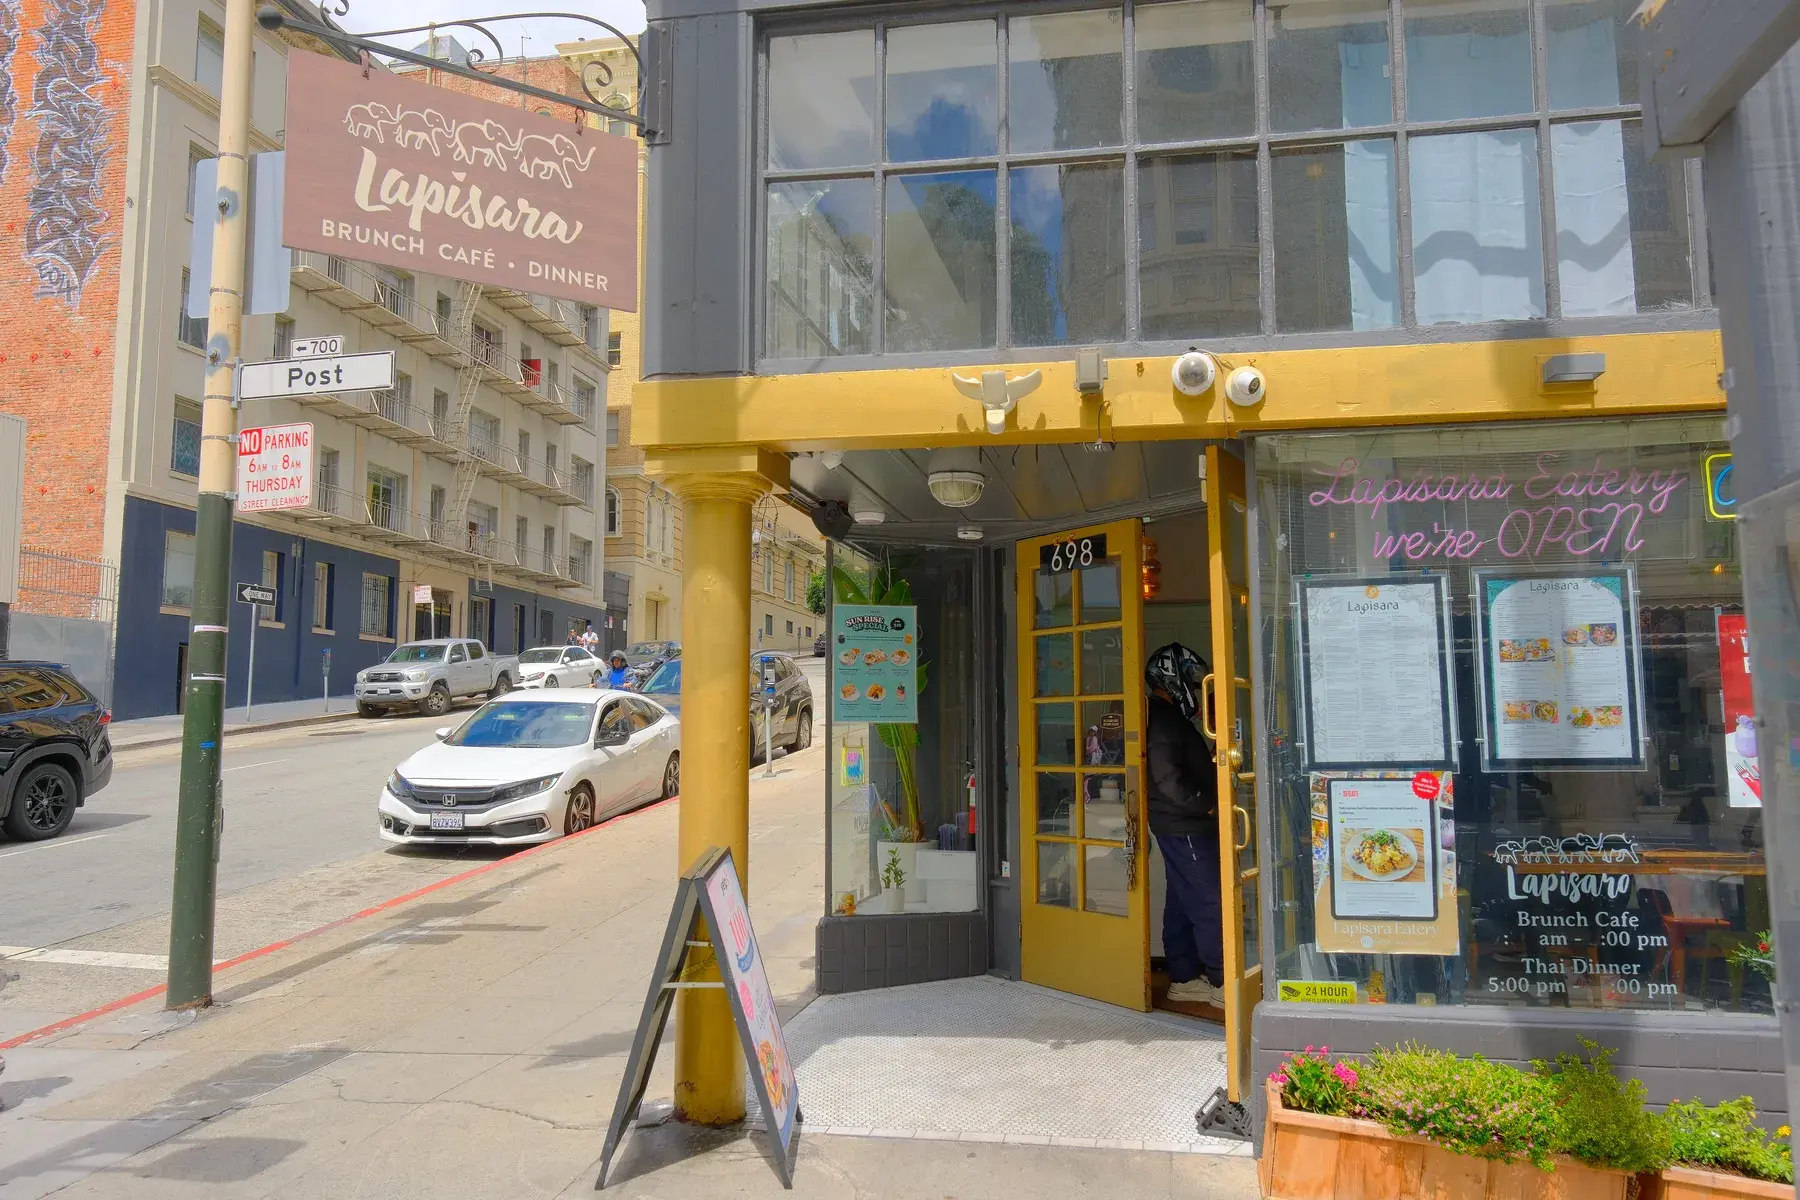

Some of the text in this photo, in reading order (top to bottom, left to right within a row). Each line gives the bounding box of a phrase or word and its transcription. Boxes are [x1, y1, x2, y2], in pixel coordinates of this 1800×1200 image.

[354, 145, 583, 244] Lapisara
[322, 218, 609, 291] BRUNCH CAFÉ DINNER
[310, 339, 338, 354] 700
[288, 364, 343, 388] Post
[241, 431, 308, 453] NO PARKING
[246, 476, 302, 493] THURSDAY
[1309, 457, 1513, 520] Lapisara
[1524, 452, 1688, 514] Eatery
[243, 496, 304, 509] STREET CLEANING
[1372, 502, 1645, 560] we're OPEN
[1051, 538, 1093, 572] 698
[1530, 580, 1579, 594] Lapisara
[1347, 601, 1399, 614] Lapisara
[853, 623, 889, 632] SPECIAL
[1517, 911, 1589, 927] Brunch
[1333, 922, 1439, 937] Lapisara Eatery
[1539, 934, 1568, 946] am
[1637, 934, 1668, 950] pm
[1521, 958, 1641, 975] Thai Dinner
[1305, 986, 1348, 997] 24 HOUR
[1488, 977, 1529, 993] 5:00
[1536, 981, 1567, 997] pm
[1648, 983, 1678, 999] pm
